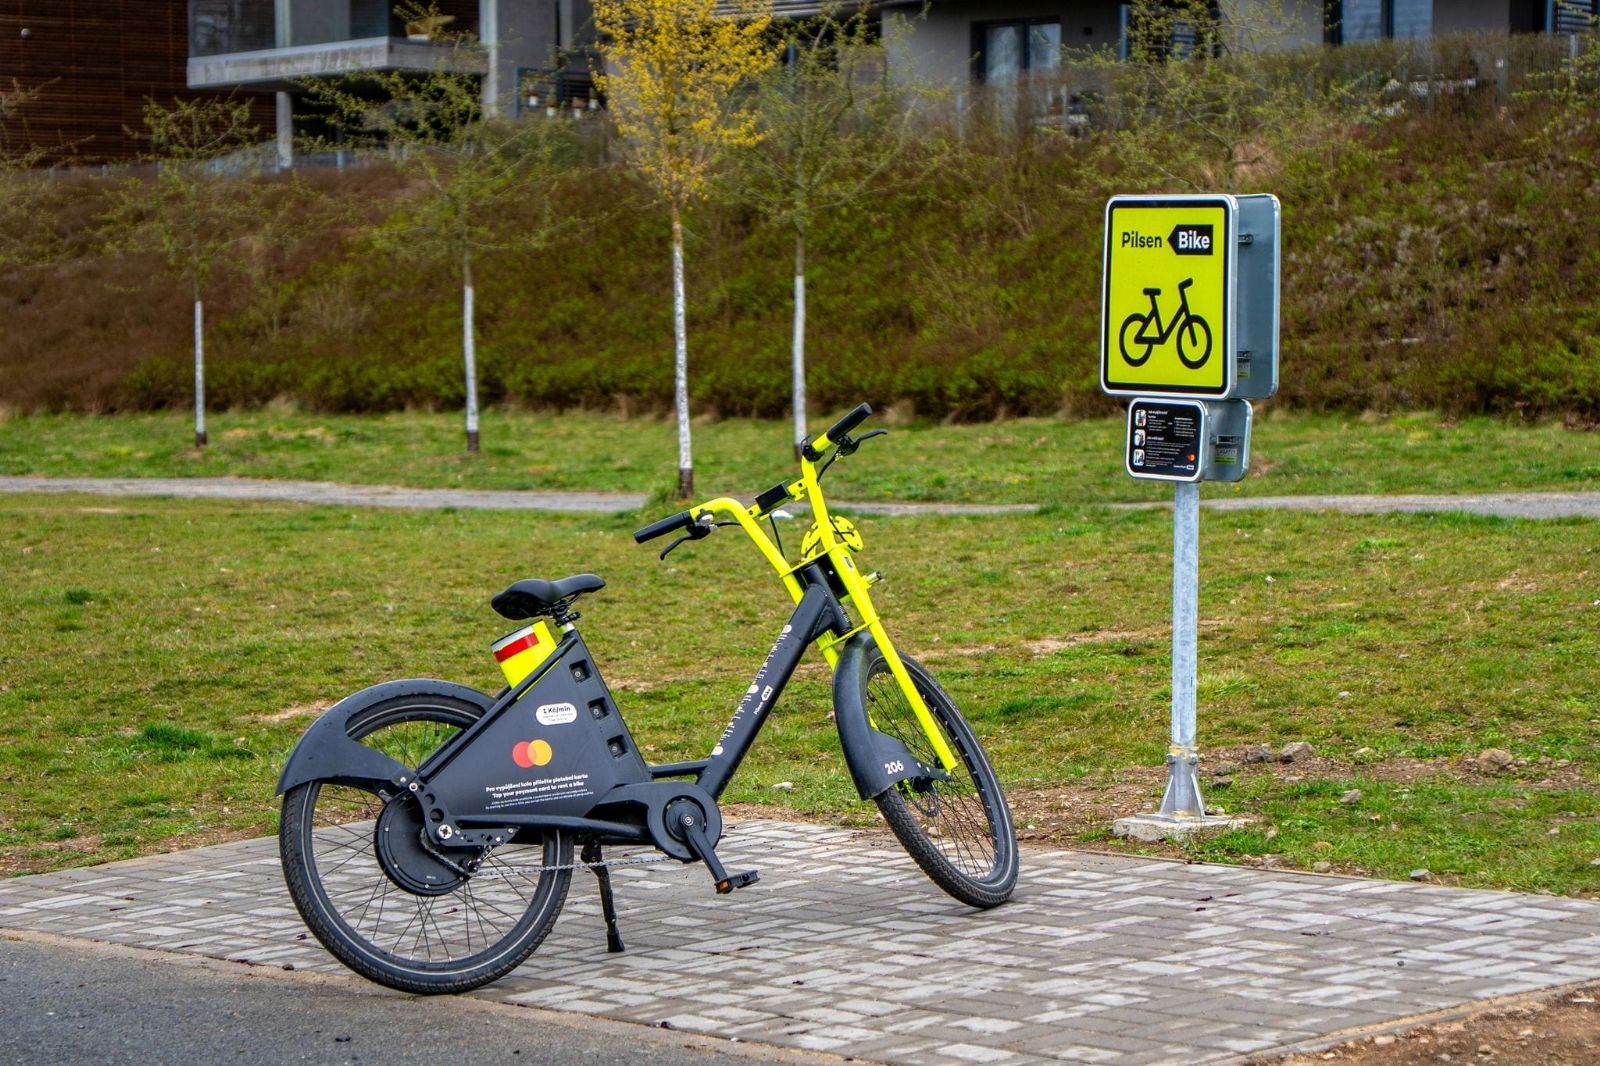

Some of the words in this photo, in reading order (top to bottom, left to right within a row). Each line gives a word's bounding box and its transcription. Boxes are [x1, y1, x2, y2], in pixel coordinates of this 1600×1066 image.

[1122, 231, 1162, 248] Pilsen
[1178, 230, 1210, 249] Bike
[885, 760, 904, 775] 206
[515, 786, 538, 797] payment
[538, 784, 550, 792] card
